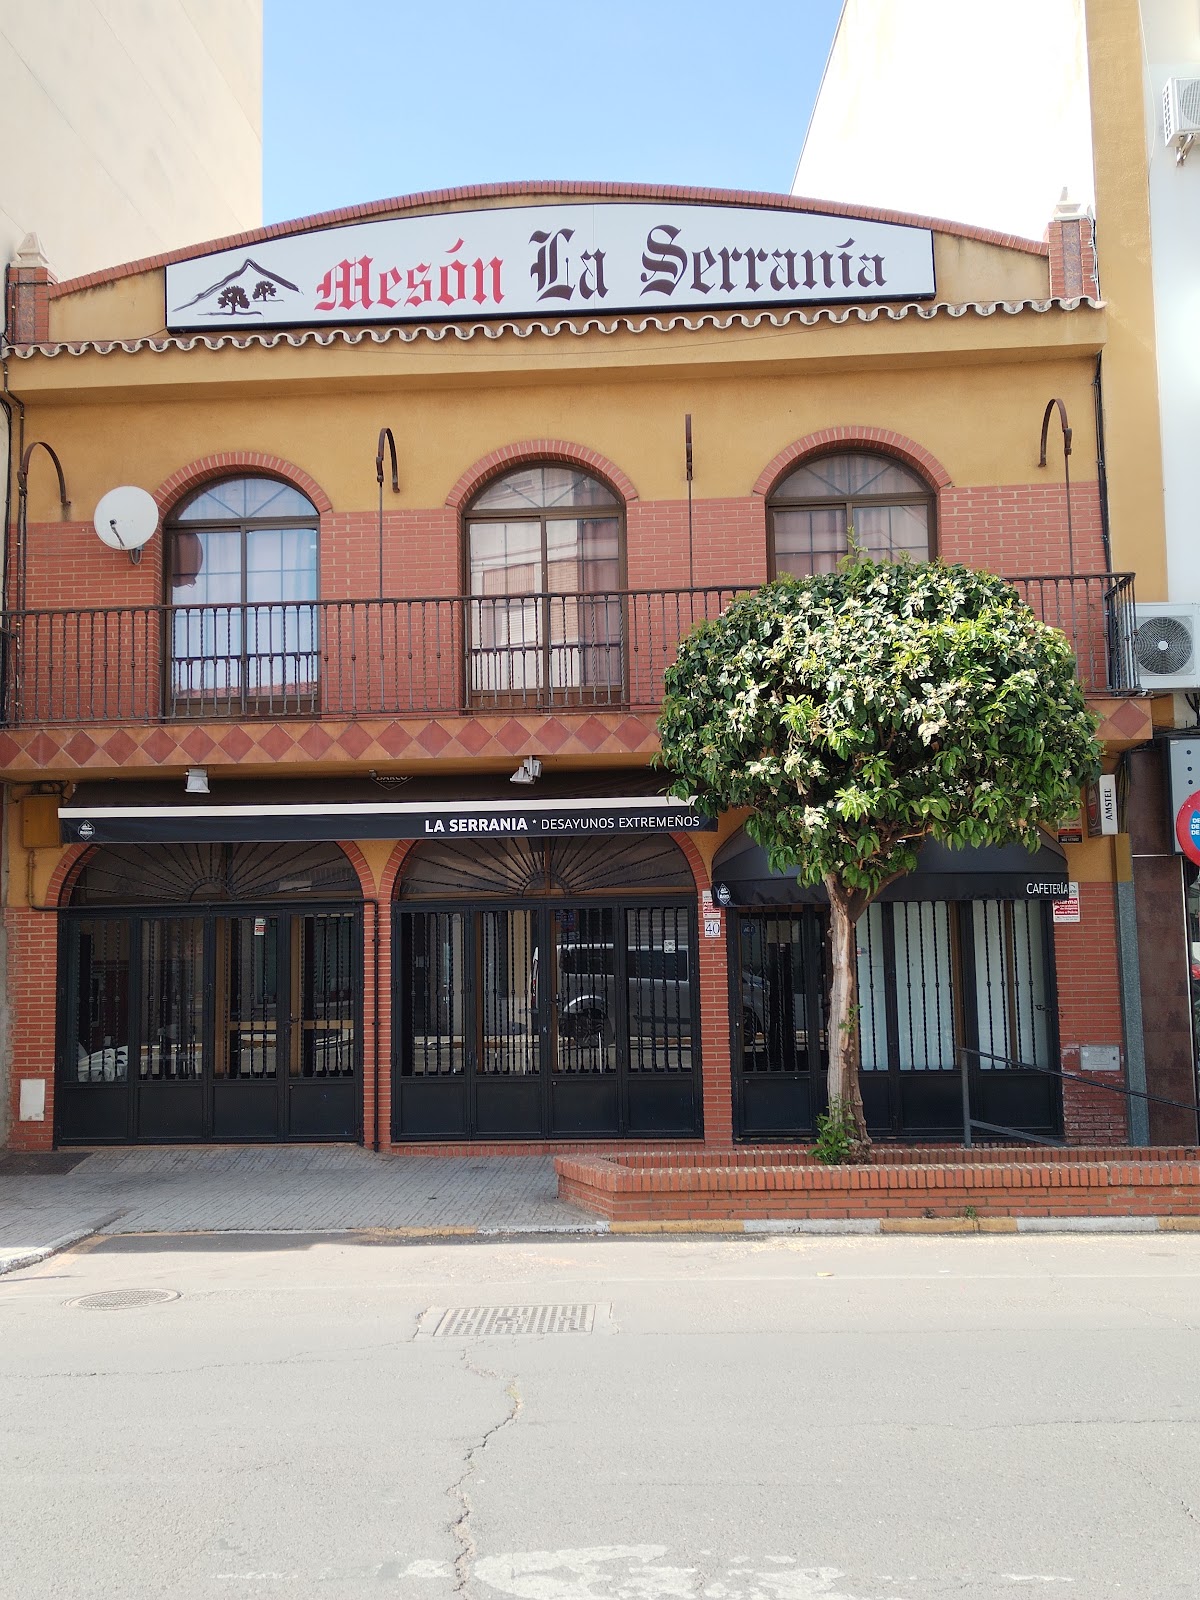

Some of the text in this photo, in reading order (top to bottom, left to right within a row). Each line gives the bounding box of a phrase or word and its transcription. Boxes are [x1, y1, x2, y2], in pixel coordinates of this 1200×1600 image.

[314, 224, 888, 311] Mesón La Serranía
[1104, 788, 1113, 821] AMSTEL
[425, 814, 700, 833] LA SERRANIA DESAYUNOS EXTREMEÑOS
[1026, 881, 1069, 895] CAFETERÍA
[705, 922, 720, 934] 40
